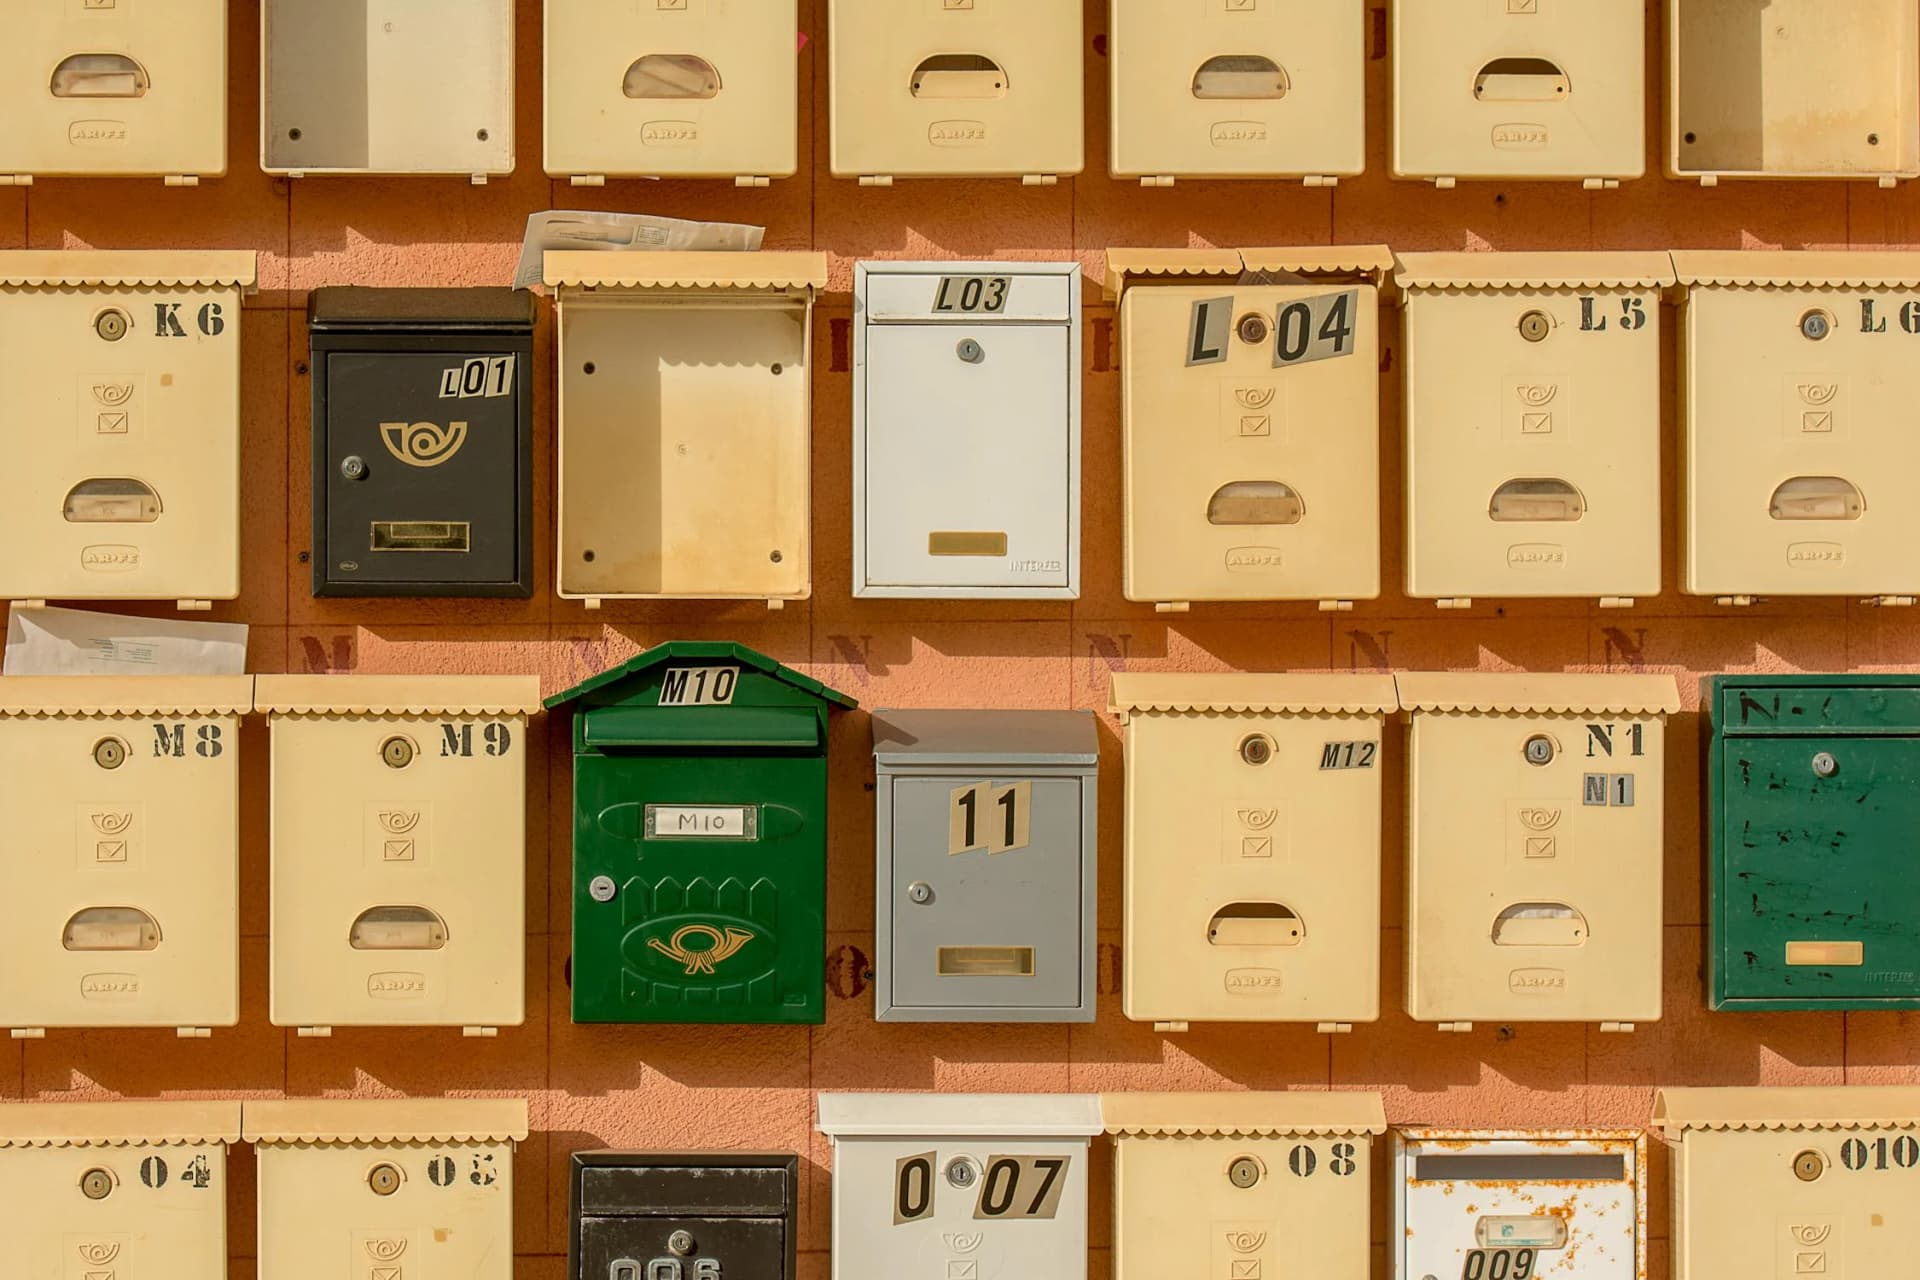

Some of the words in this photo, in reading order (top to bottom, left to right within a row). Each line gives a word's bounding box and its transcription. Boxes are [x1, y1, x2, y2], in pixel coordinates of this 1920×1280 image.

[937, 278, 1007, 311] L03
[1192, 303, 1220, 361] L
[1277, 294, 1351, 362] 04
[444, 358, 508, 396] L01
[661, 669, 735, 703] M10
[1320, 742, 1375, 768] M12
[959, 788, 1015, 848] 11
[981, 1158, 1064, 1218] 07
